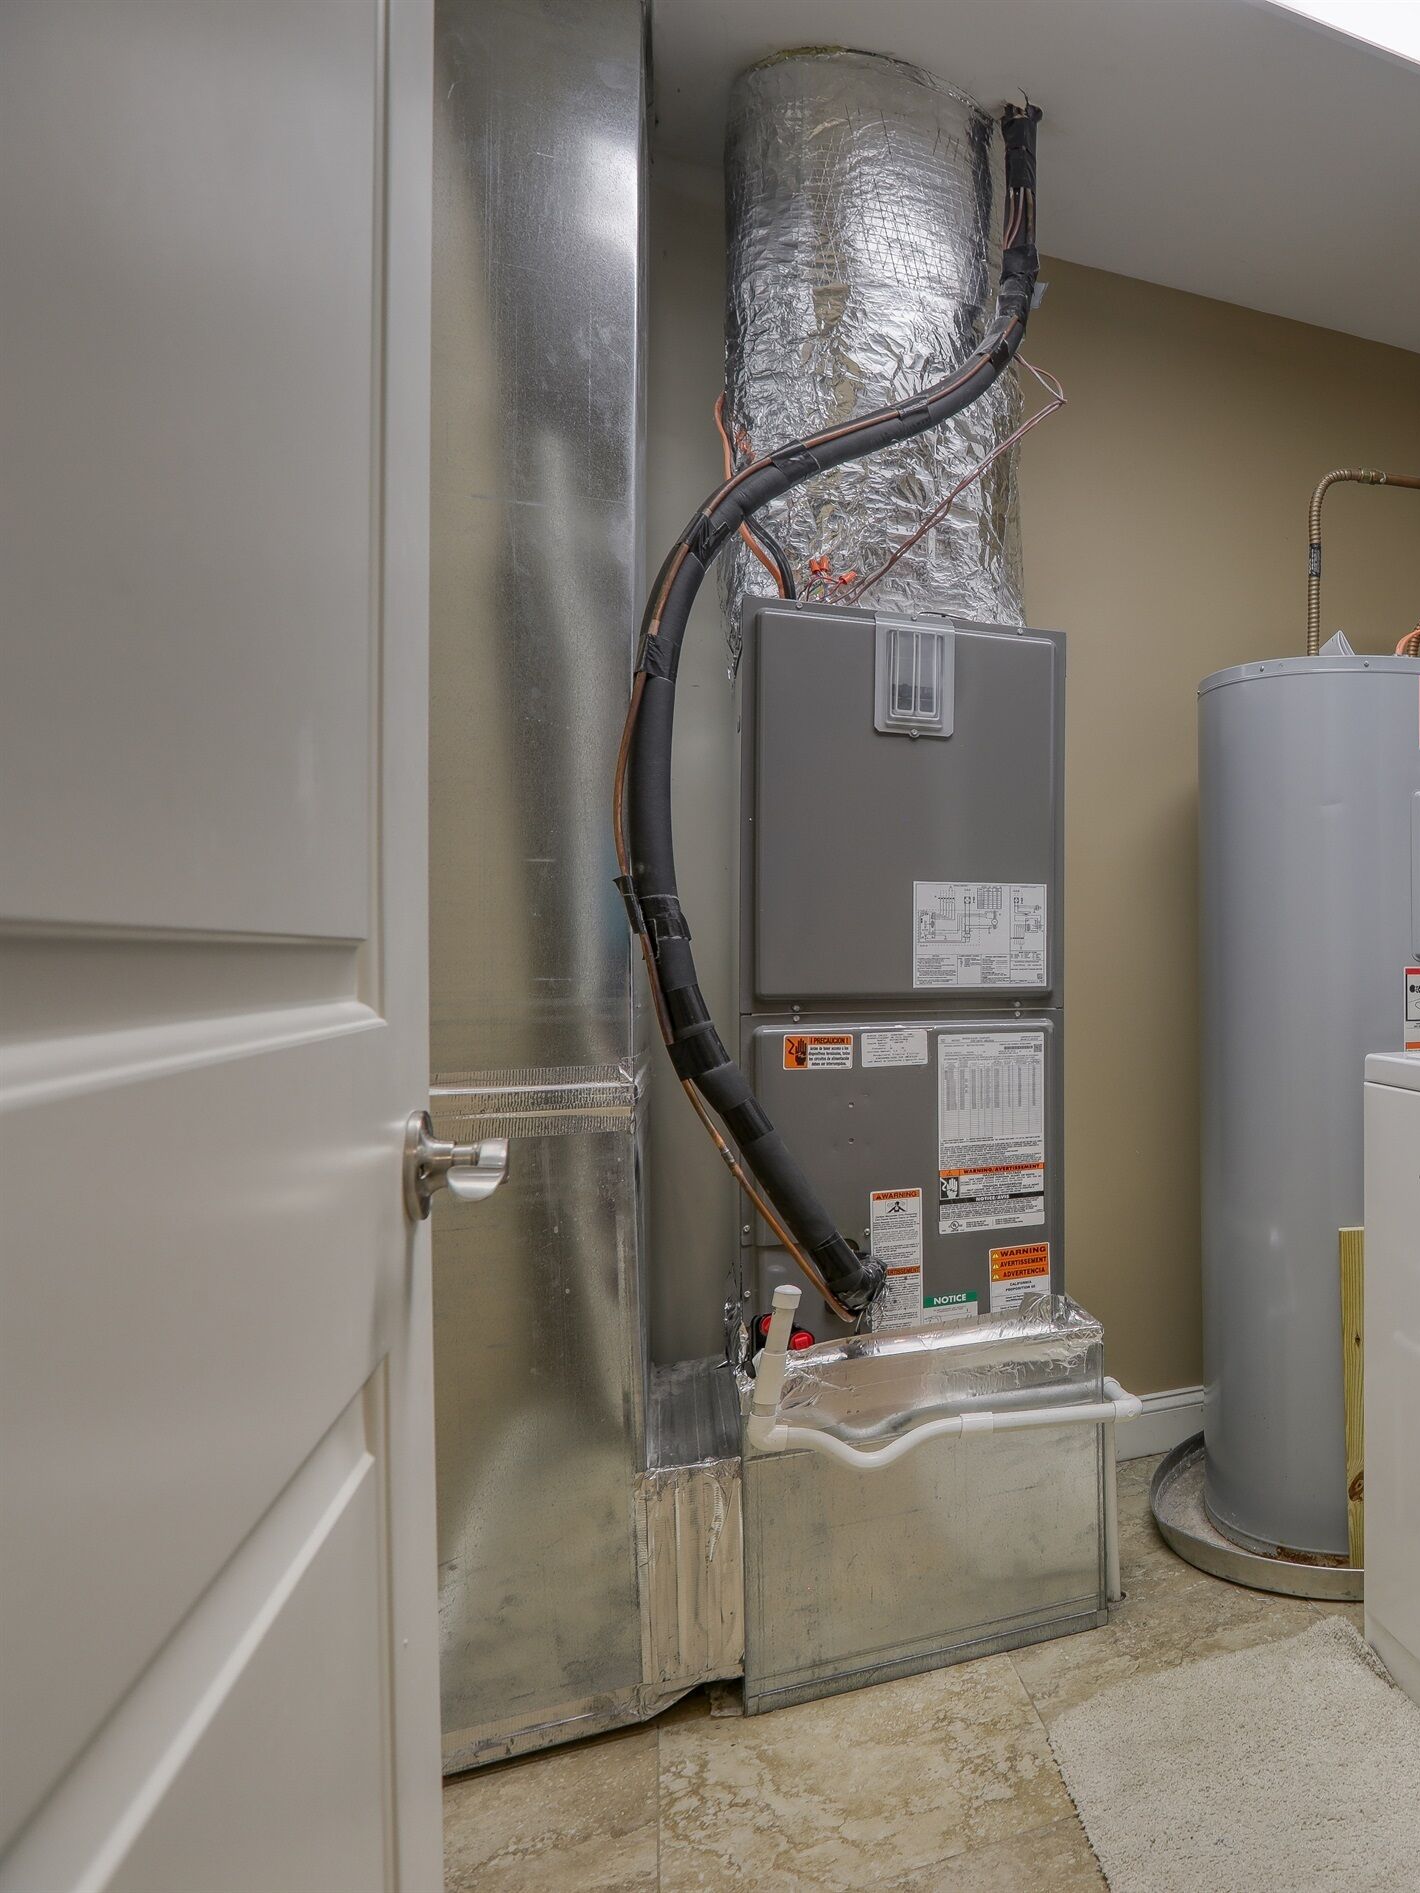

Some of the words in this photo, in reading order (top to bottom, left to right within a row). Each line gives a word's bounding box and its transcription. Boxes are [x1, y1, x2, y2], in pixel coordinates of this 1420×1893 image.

[882, 1191, 917, 1200] WARNING
[1000, 1246, 1046, 1257] WARNING
[1000, 1256, 1046, 1268] AVERTISSEMENT
[1003, 1267, 1046, 1278] ADVERTENCIA
[933, 1293, 967, 1305] NOTICE
